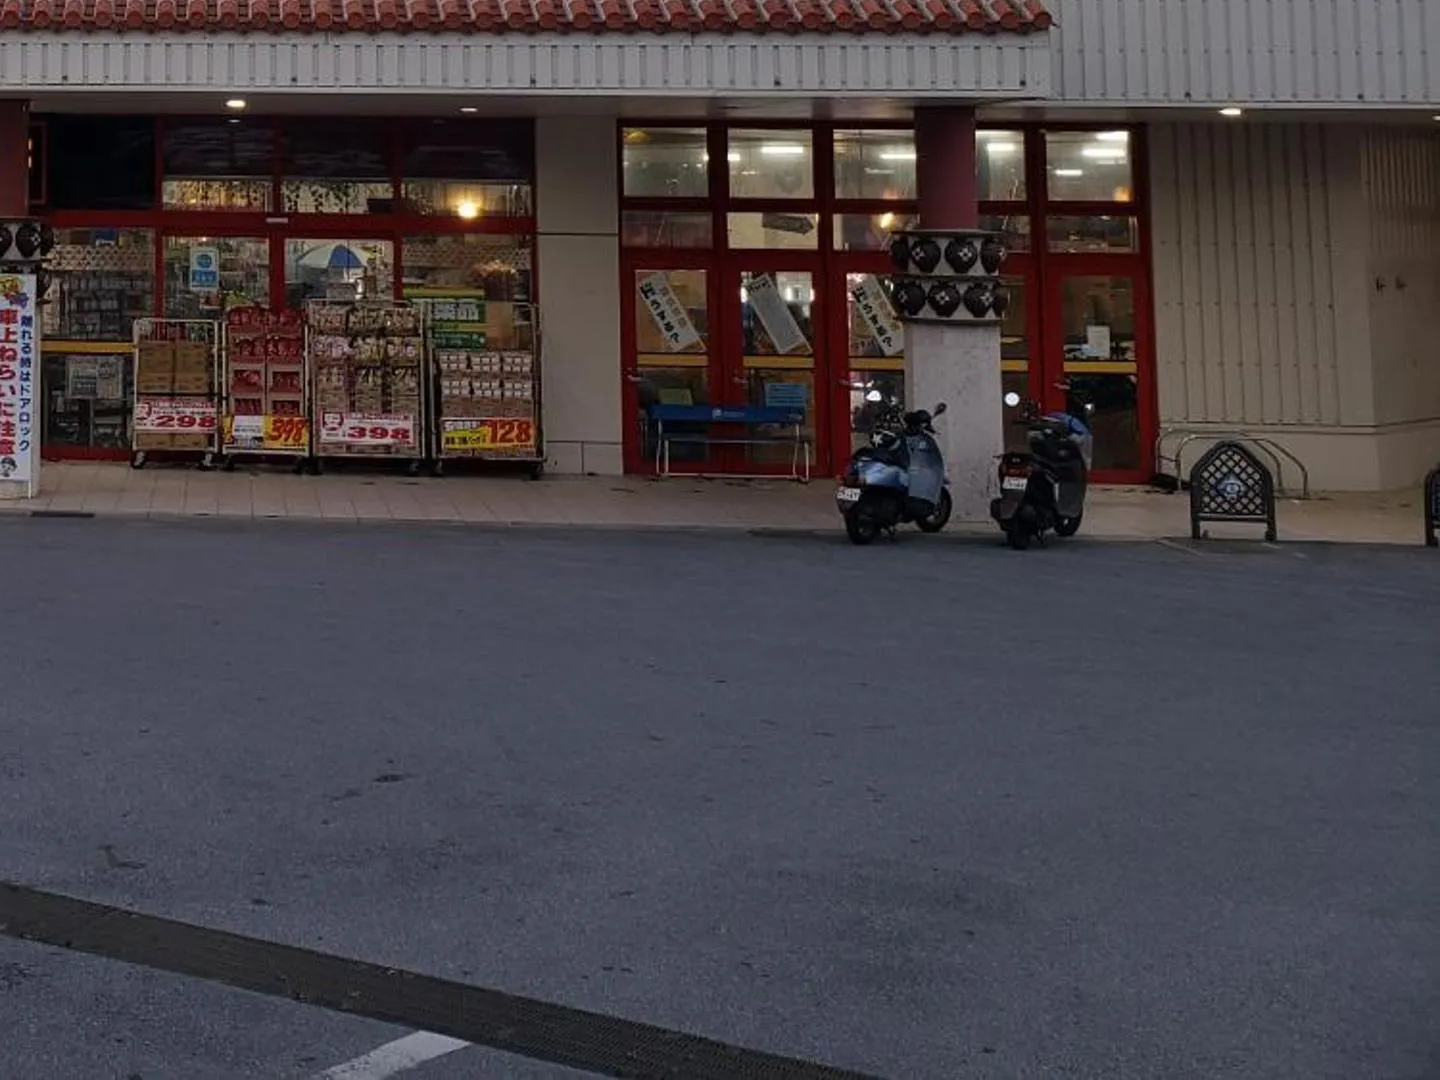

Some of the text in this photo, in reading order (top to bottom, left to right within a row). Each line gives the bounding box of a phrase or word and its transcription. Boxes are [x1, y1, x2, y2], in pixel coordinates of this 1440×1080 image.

[19, 315, 33, 452] 離れる時はドアロック
[155, 415, 216, 428] 298
[489, 422, 532, 443] 128
